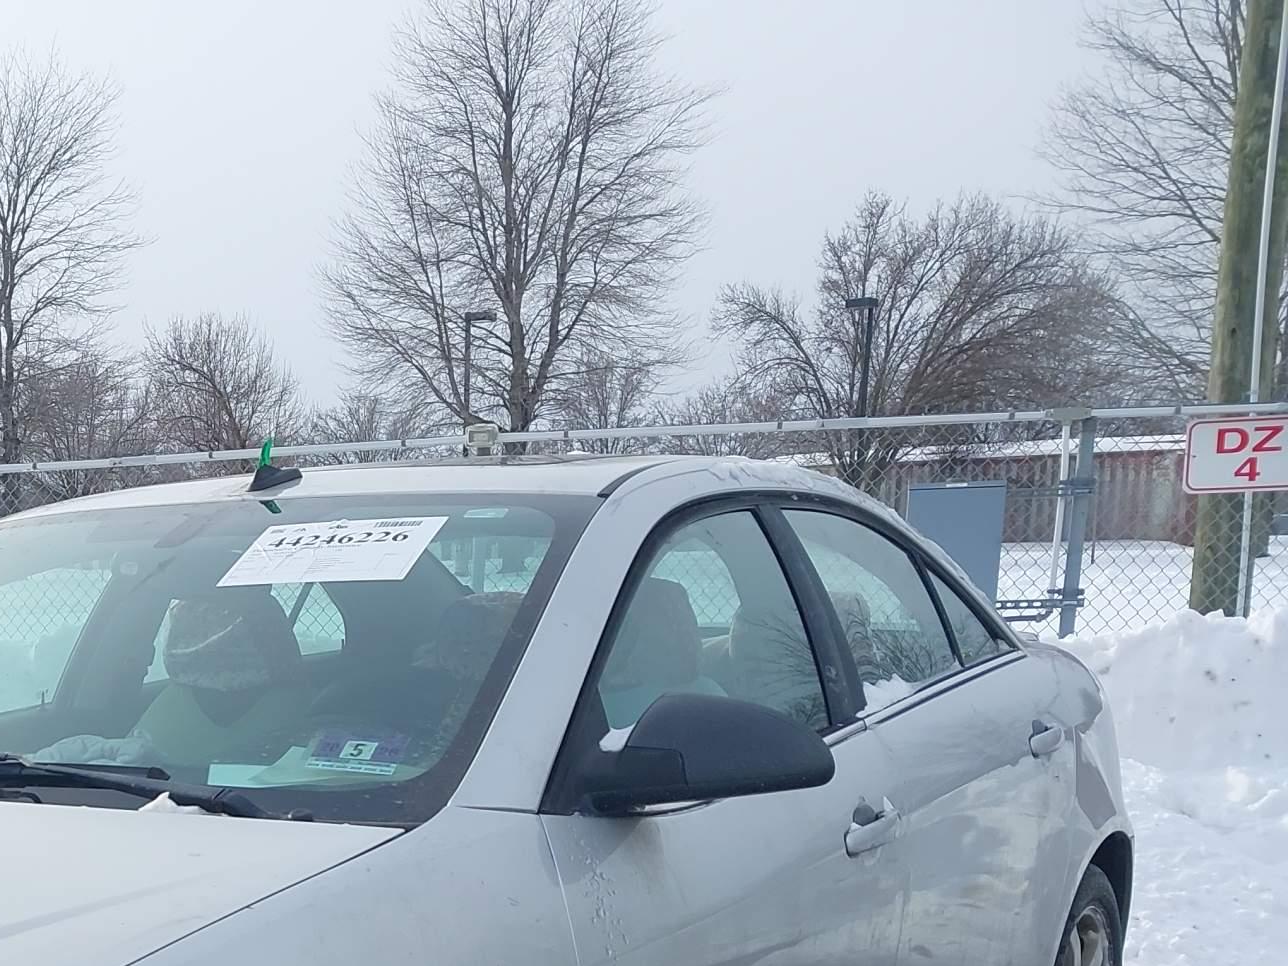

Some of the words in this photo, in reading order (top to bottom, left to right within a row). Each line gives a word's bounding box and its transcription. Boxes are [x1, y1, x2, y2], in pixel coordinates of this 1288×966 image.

[1216, 425, 1285, 454] DZ
[1234, 457, 1261, 482] 4
[267, 530, 412, 548] 44246226
[349, 743, 367, 757] 5
